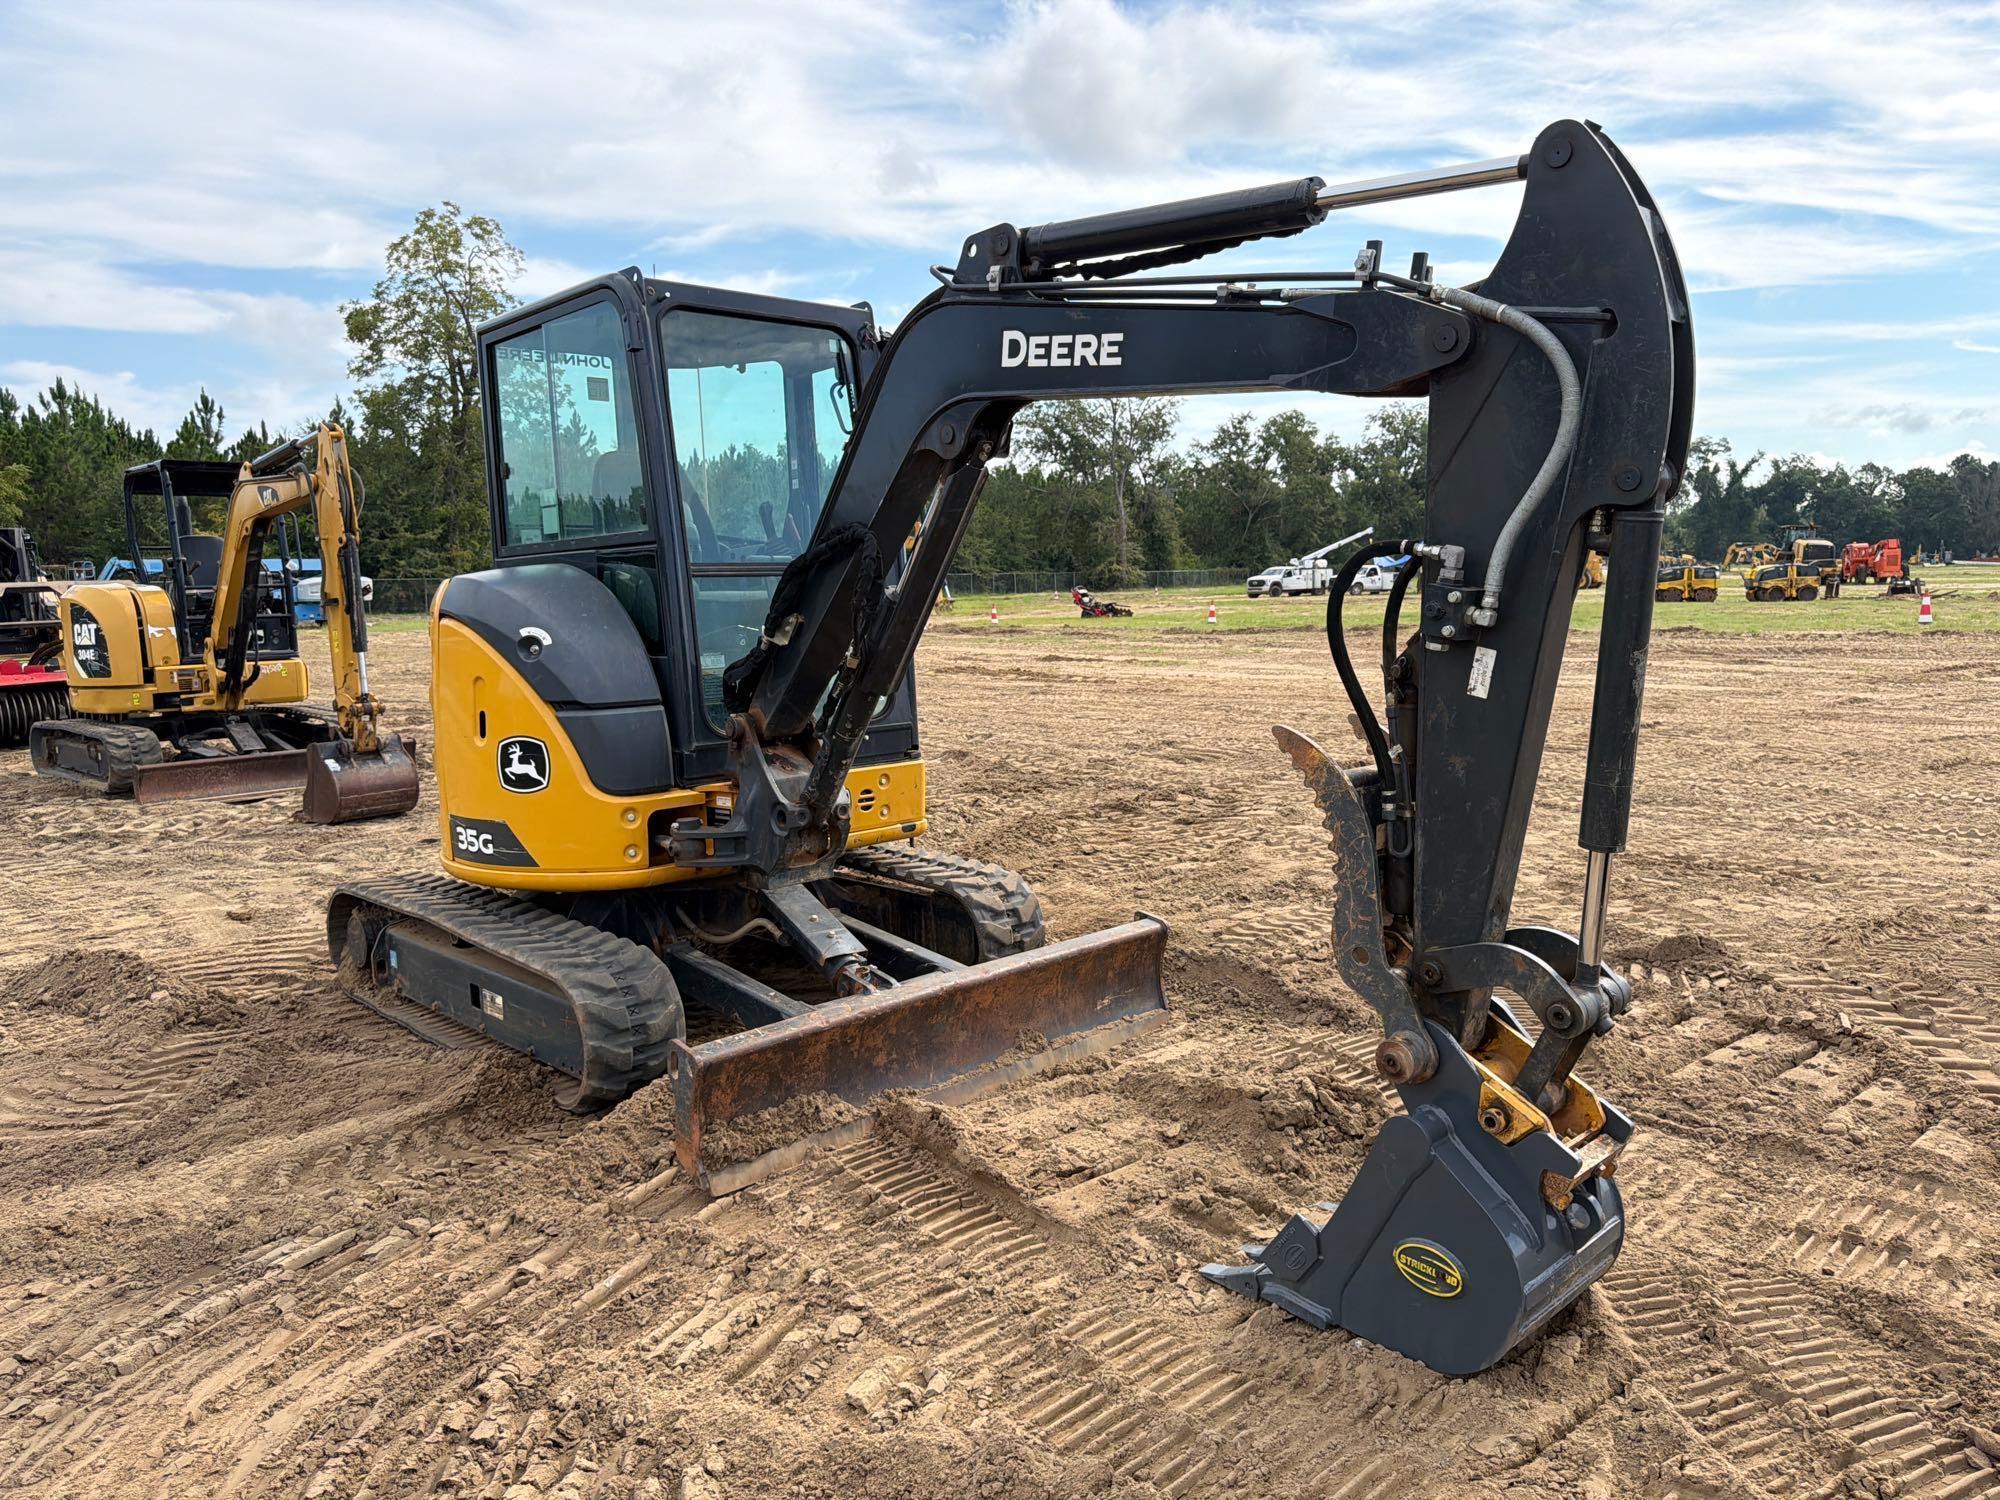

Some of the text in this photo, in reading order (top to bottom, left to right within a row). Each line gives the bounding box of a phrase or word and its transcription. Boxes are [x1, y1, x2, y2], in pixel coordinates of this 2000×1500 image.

[1001, 330, 1124, 368] DEERE
[74, 623, 97, 646] CAT
[456, 826, 494, 855] 35G
